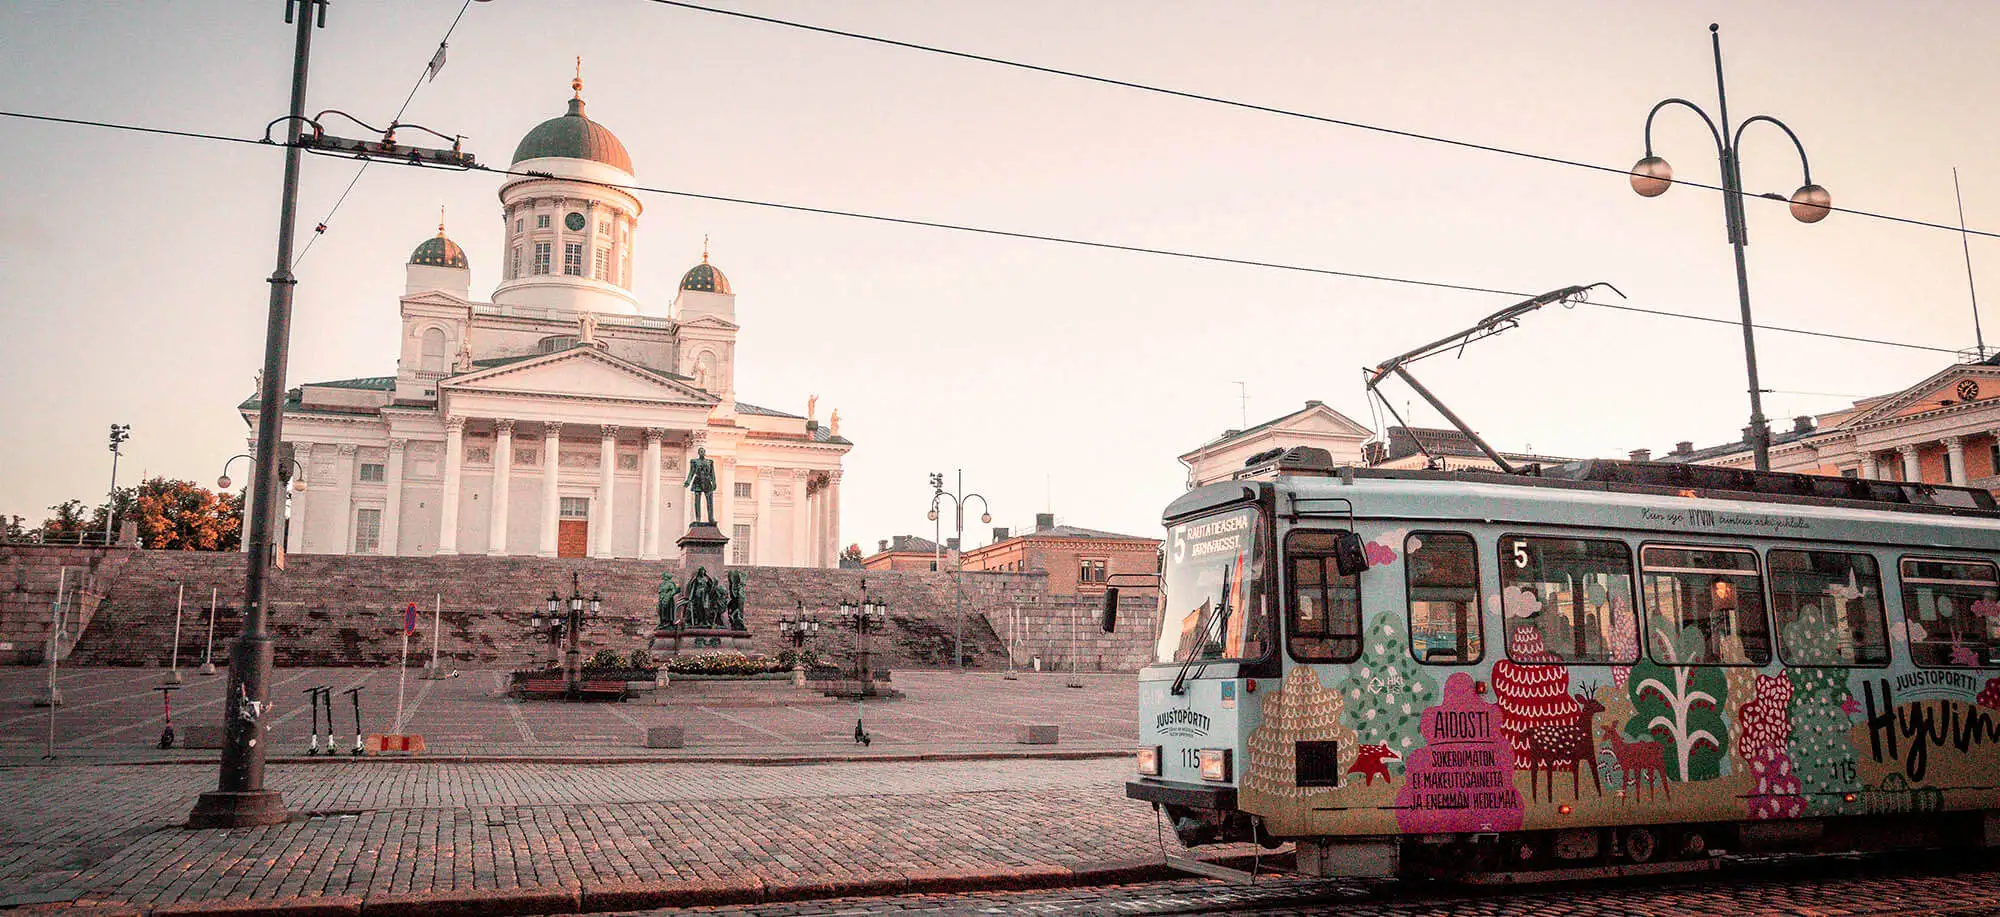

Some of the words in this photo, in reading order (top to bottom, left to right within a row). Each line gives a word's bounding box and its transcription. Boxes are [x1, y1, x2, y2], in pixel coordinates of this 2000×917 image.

[1688, 508, 1715, 527] HYVIN
[1173, 525, 1186, 563] 5
[1513, 541, 1528, 568] 5
[1896, 671, 1977, 692] JUUSTOPORTTI
[1156, 710, 1210, 731] JUUSTOPORTTI
[1434, 711, 1490, 738] AIDOSTI
[1181, 748, 1200, 768] 115
[1432, 750, 1495, 767] SOKEROIMATON
[1412, 773, 1421, 789] EI
[1831, 760, 1856, 784] 115
